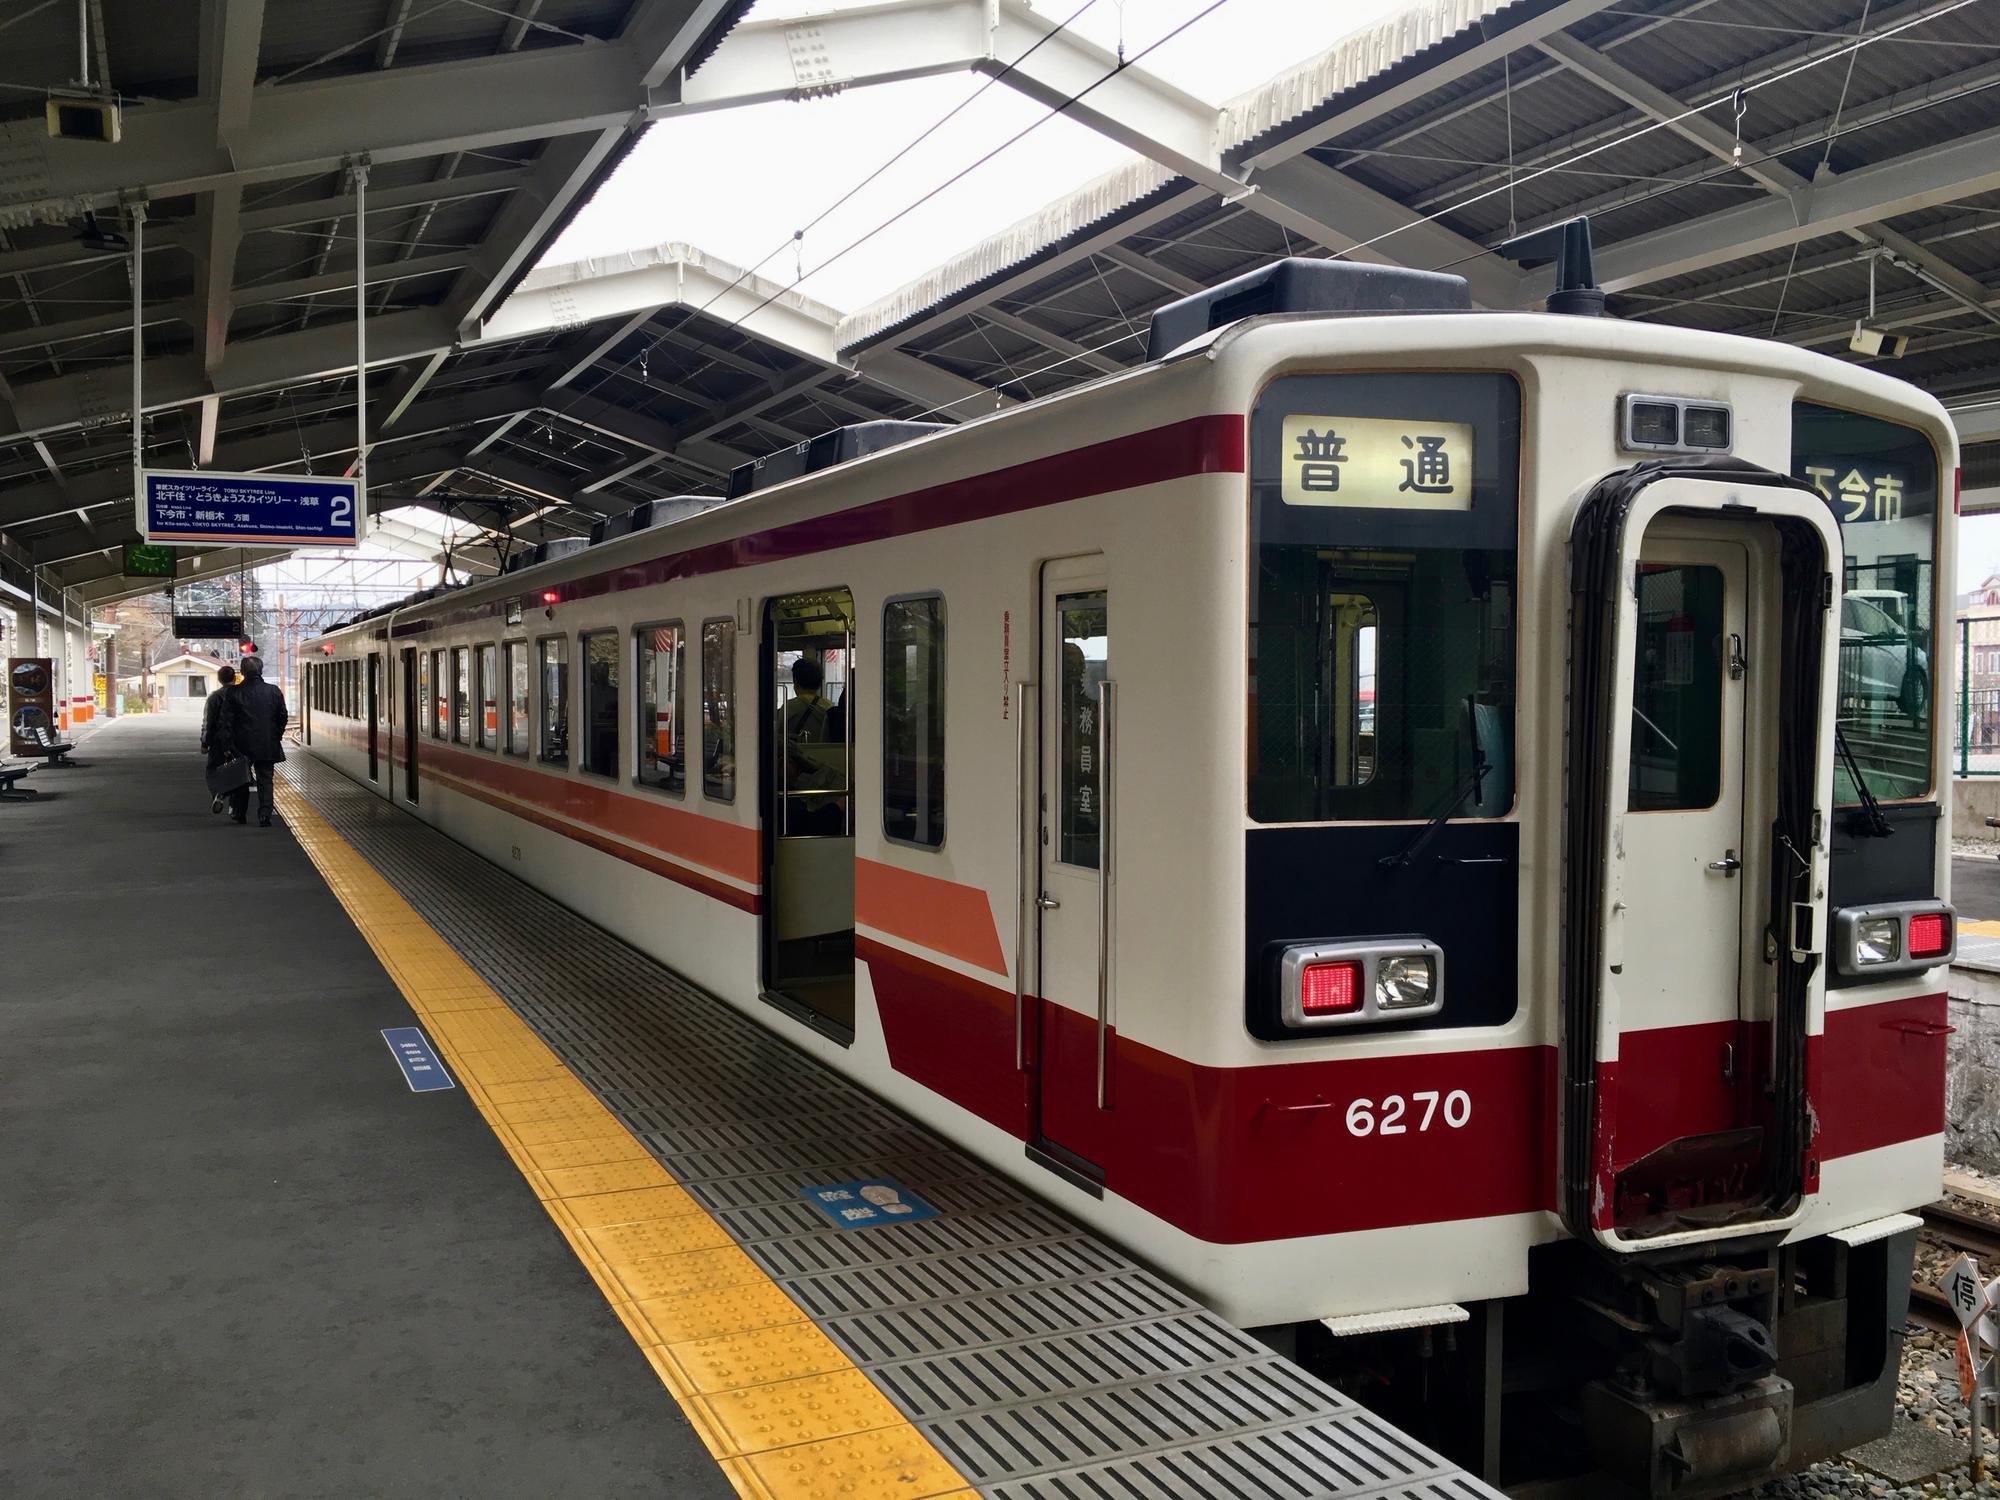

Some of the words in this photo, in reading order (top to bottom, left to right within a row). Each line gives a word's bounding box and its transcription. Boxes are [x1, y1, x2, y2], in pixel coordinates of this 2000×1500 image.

[1293, 428, 1454, 494] 普通
[330, 496, 351, 527] 2
[1805, 466, 1904, 525] 下今市
[1345, 1089, 1472, 1137] 6270
[1952, 1272, 1977, 1313] 停
